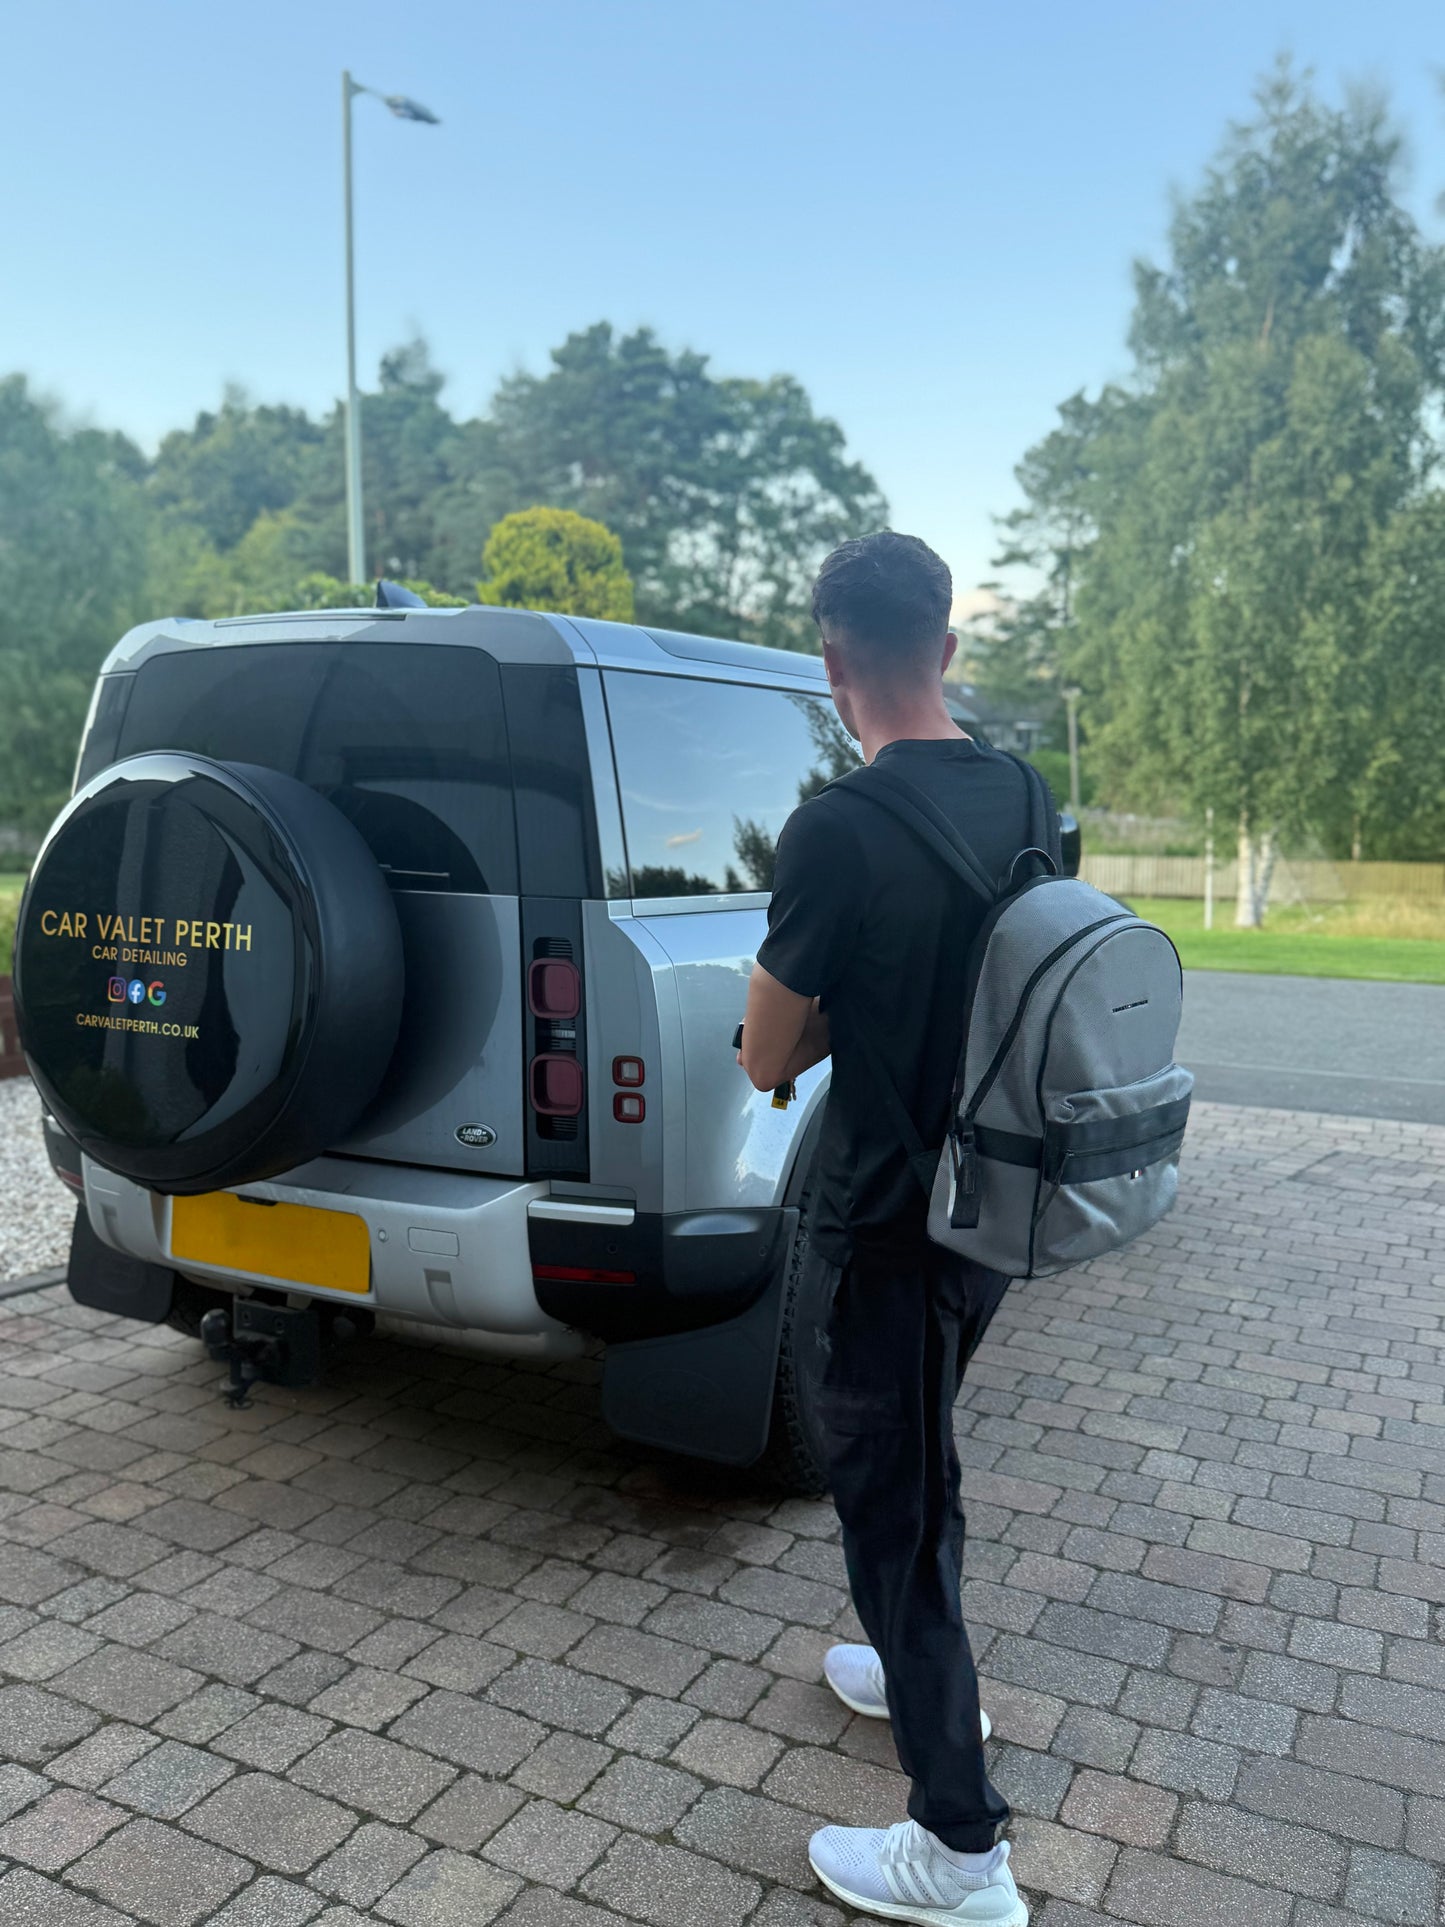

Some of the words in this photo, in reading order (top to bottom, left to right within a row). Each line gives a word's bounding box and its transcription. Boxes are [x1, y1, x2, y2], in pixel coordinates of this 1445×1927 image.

[41, 909, 88, 939] CAR
[96, 914, 165, 945] VALET
[175, 919, 252, 952] PERTH
[92, 945, 117, 961] CAR
[122, 949, 188, 967] DETAILING
[76, 1012, 199, 1039] CARVALETPERTH.CO.UK
